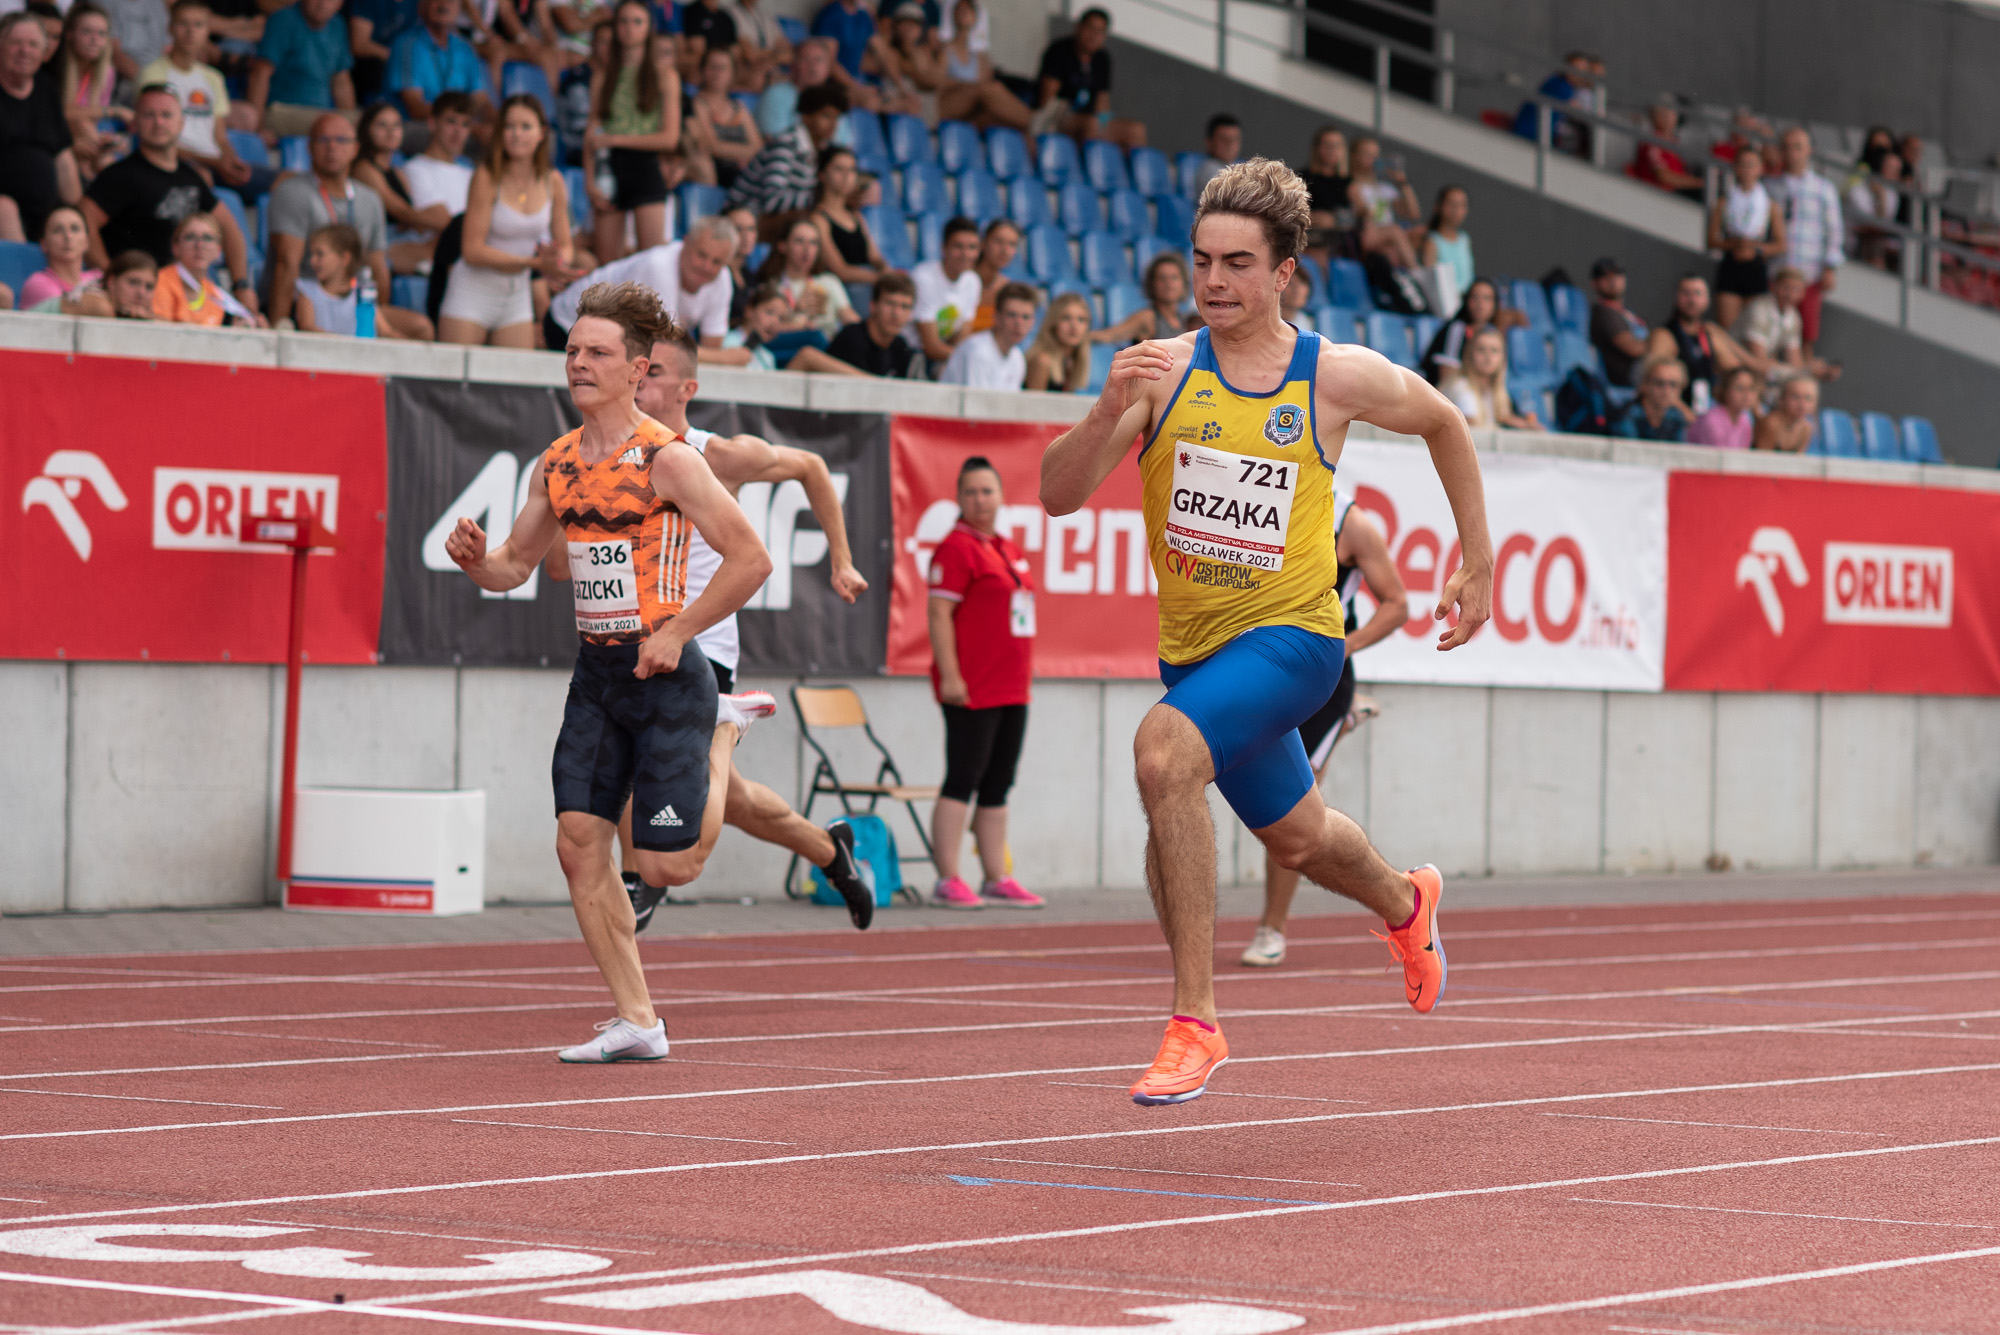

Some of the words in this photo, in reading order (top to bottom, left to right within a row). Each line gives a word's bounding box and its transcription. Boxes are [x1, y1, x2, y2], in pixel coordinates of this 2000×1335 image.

[1282, 414, 1291, 425] S
[617, 456, 645, 465] adidas
[1238, 459, 1288, 490] 721
[1174, 488, 1280, 531] GRZĄKA
[1177, 527, 1193, 536] PZLA
[1194, 531, 1241, 546] MISTRZOSTWA
[1243, 542, 1267, 551] POLSKI
[589, 544, 627, 566] 336
[1169, 535, 1243, 562] WŁOCŁAWEK
[1247, 553, 1276, 568] 2021
[1193, 573, 1261, 589] WIELKOPOLSKI
[1196, 562, 1252, 580] OSTRÓW
[1835, 557, 1942, 611] ORLEN
[613, 619, 636, 630] 2021
[650, 817, 684, 826] adidas
